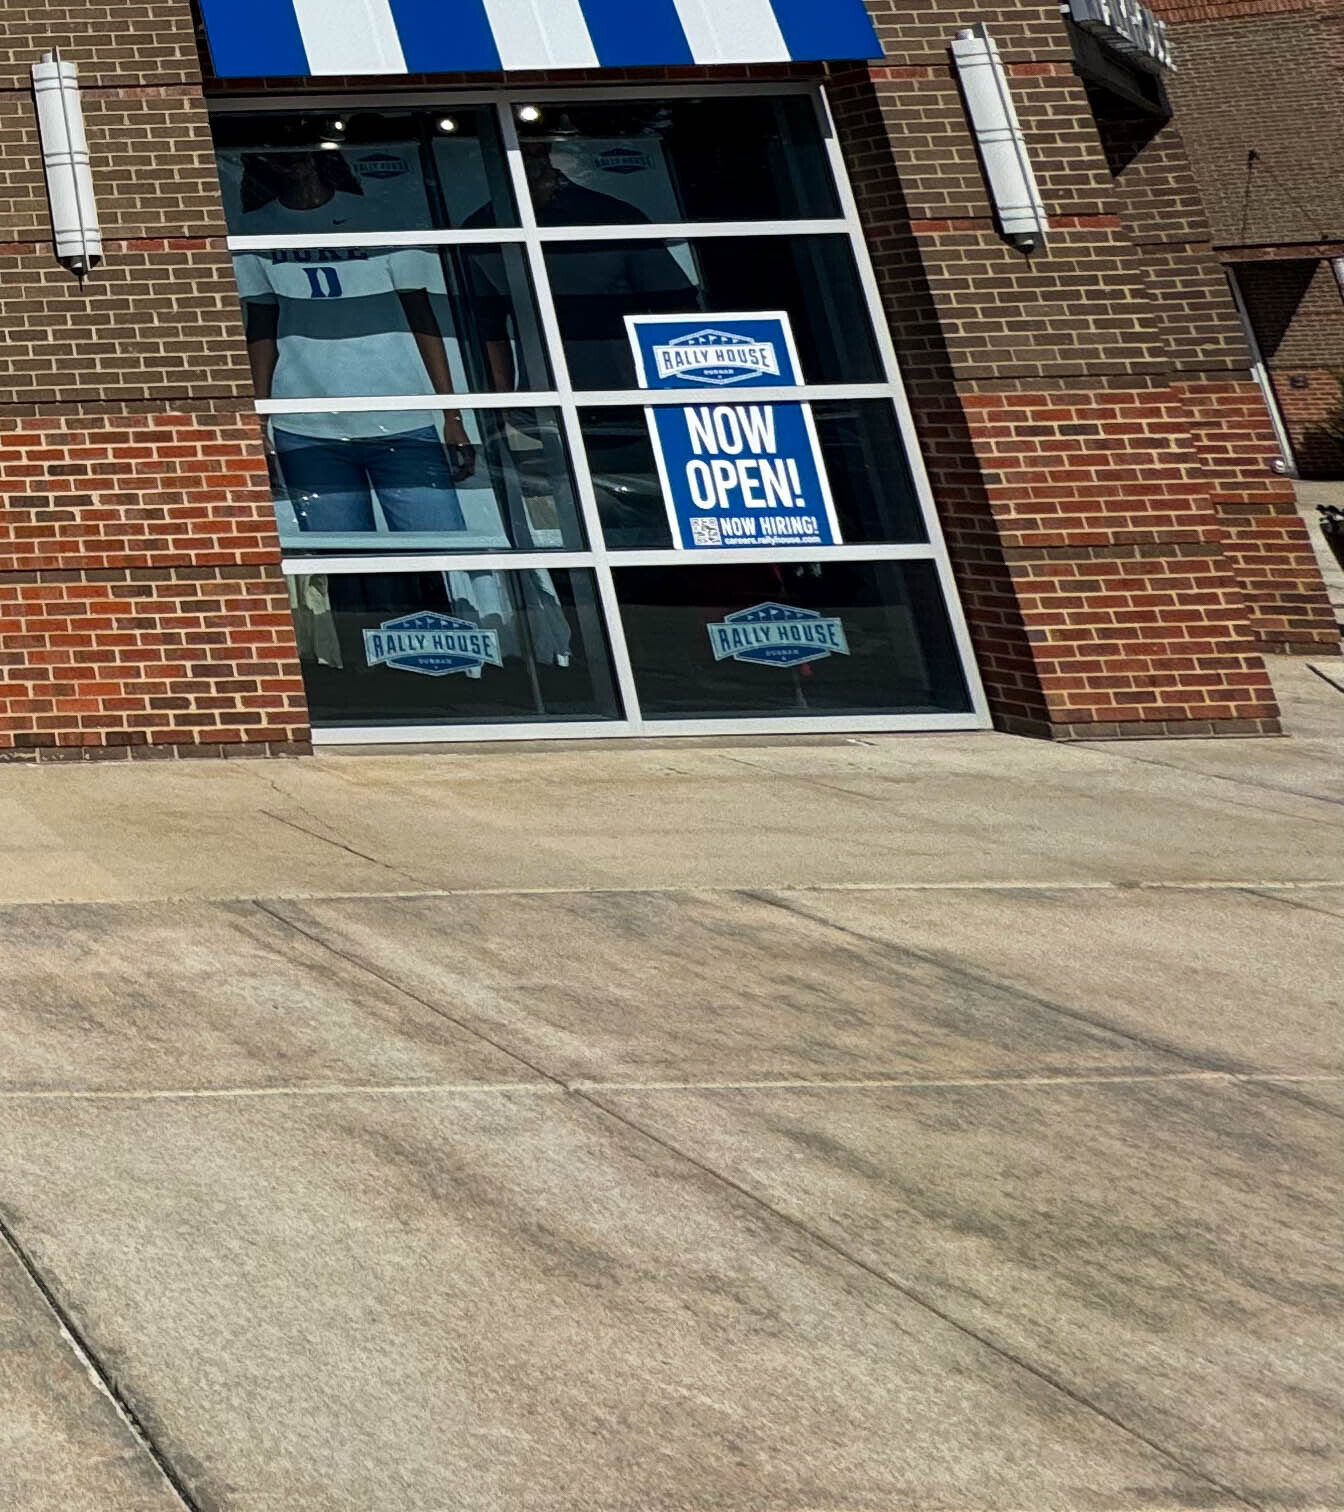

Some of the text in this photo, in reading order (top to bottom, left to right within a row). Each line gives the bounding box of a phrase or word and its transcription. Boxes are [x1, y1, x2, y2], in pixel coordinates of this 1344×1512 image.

[662, 348, 771, 370] RALLY HOUSE
[683, 405, 777, 455] NOW
[686, 458, 806, 510] OPEN!
[719, 516, 819, 536] NOW HIRING!
[372, 635, 494, 658] RALLY HOUSE
[718, 623, 839, 652] RALLY HOUSE
